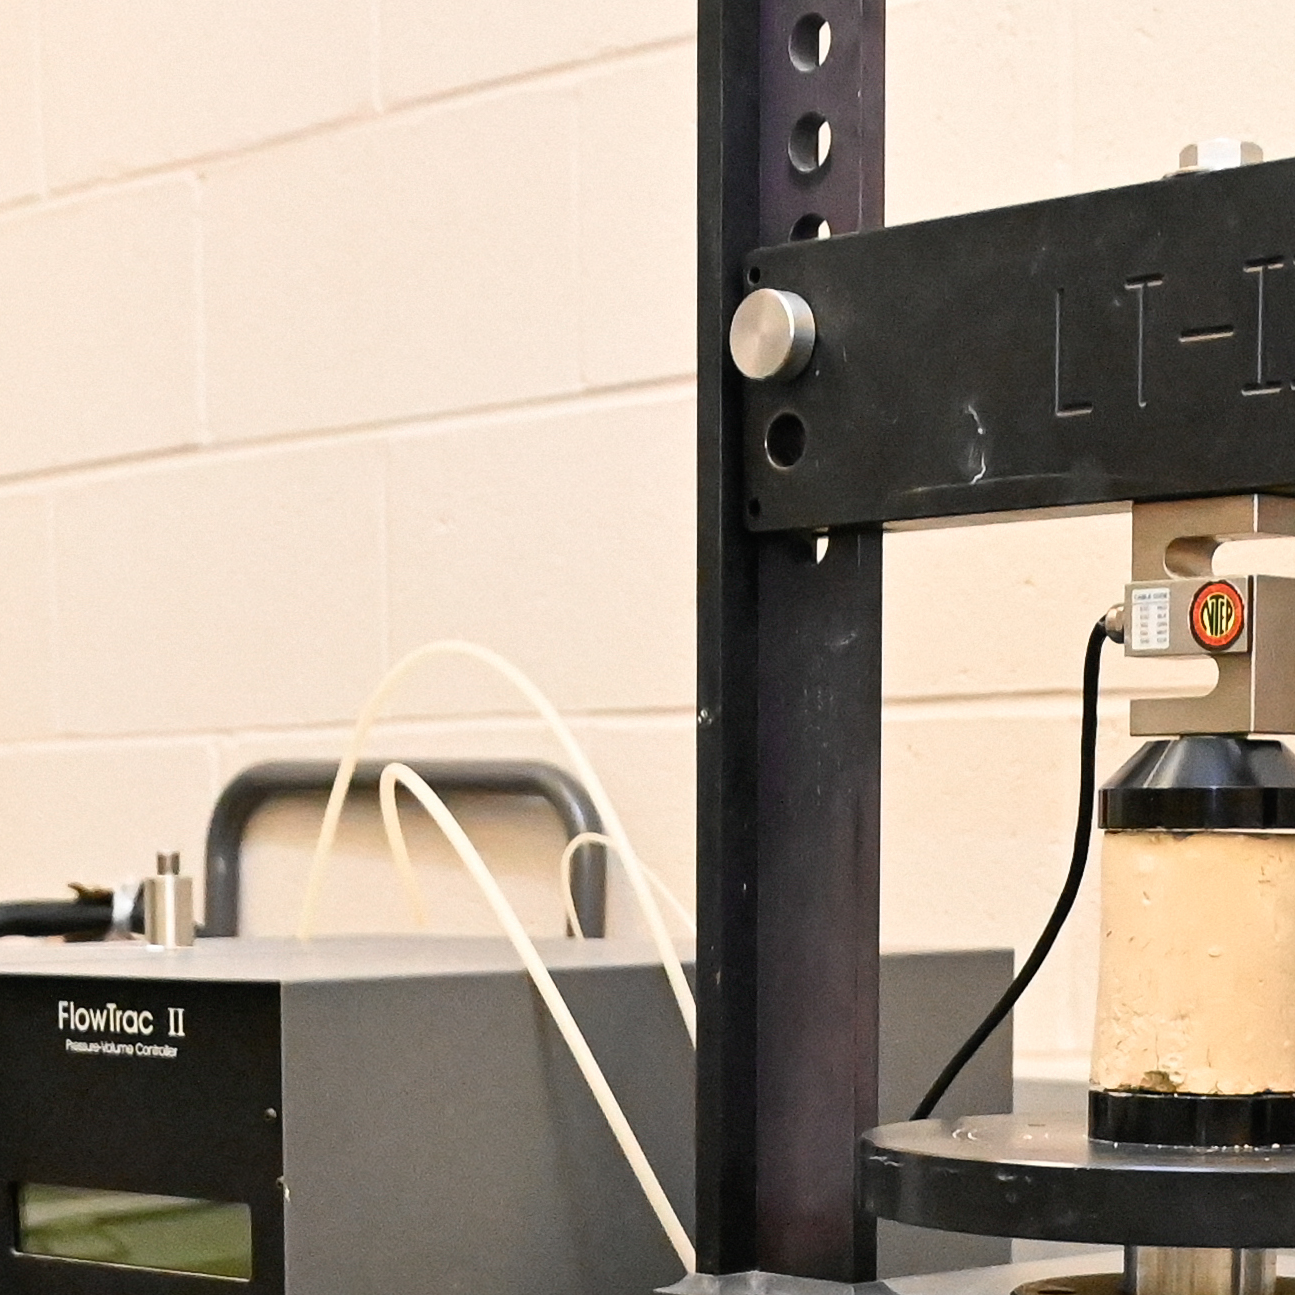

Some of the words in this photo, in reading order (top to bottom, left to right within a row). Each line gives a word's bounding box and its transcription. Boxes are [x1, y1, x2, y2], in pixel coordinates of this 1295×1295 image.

[1200, 594, 1233, 636] NTEP
[58, 1000, 154, 1035] FlowTrac
[167, 1007, 185, 1037] II
